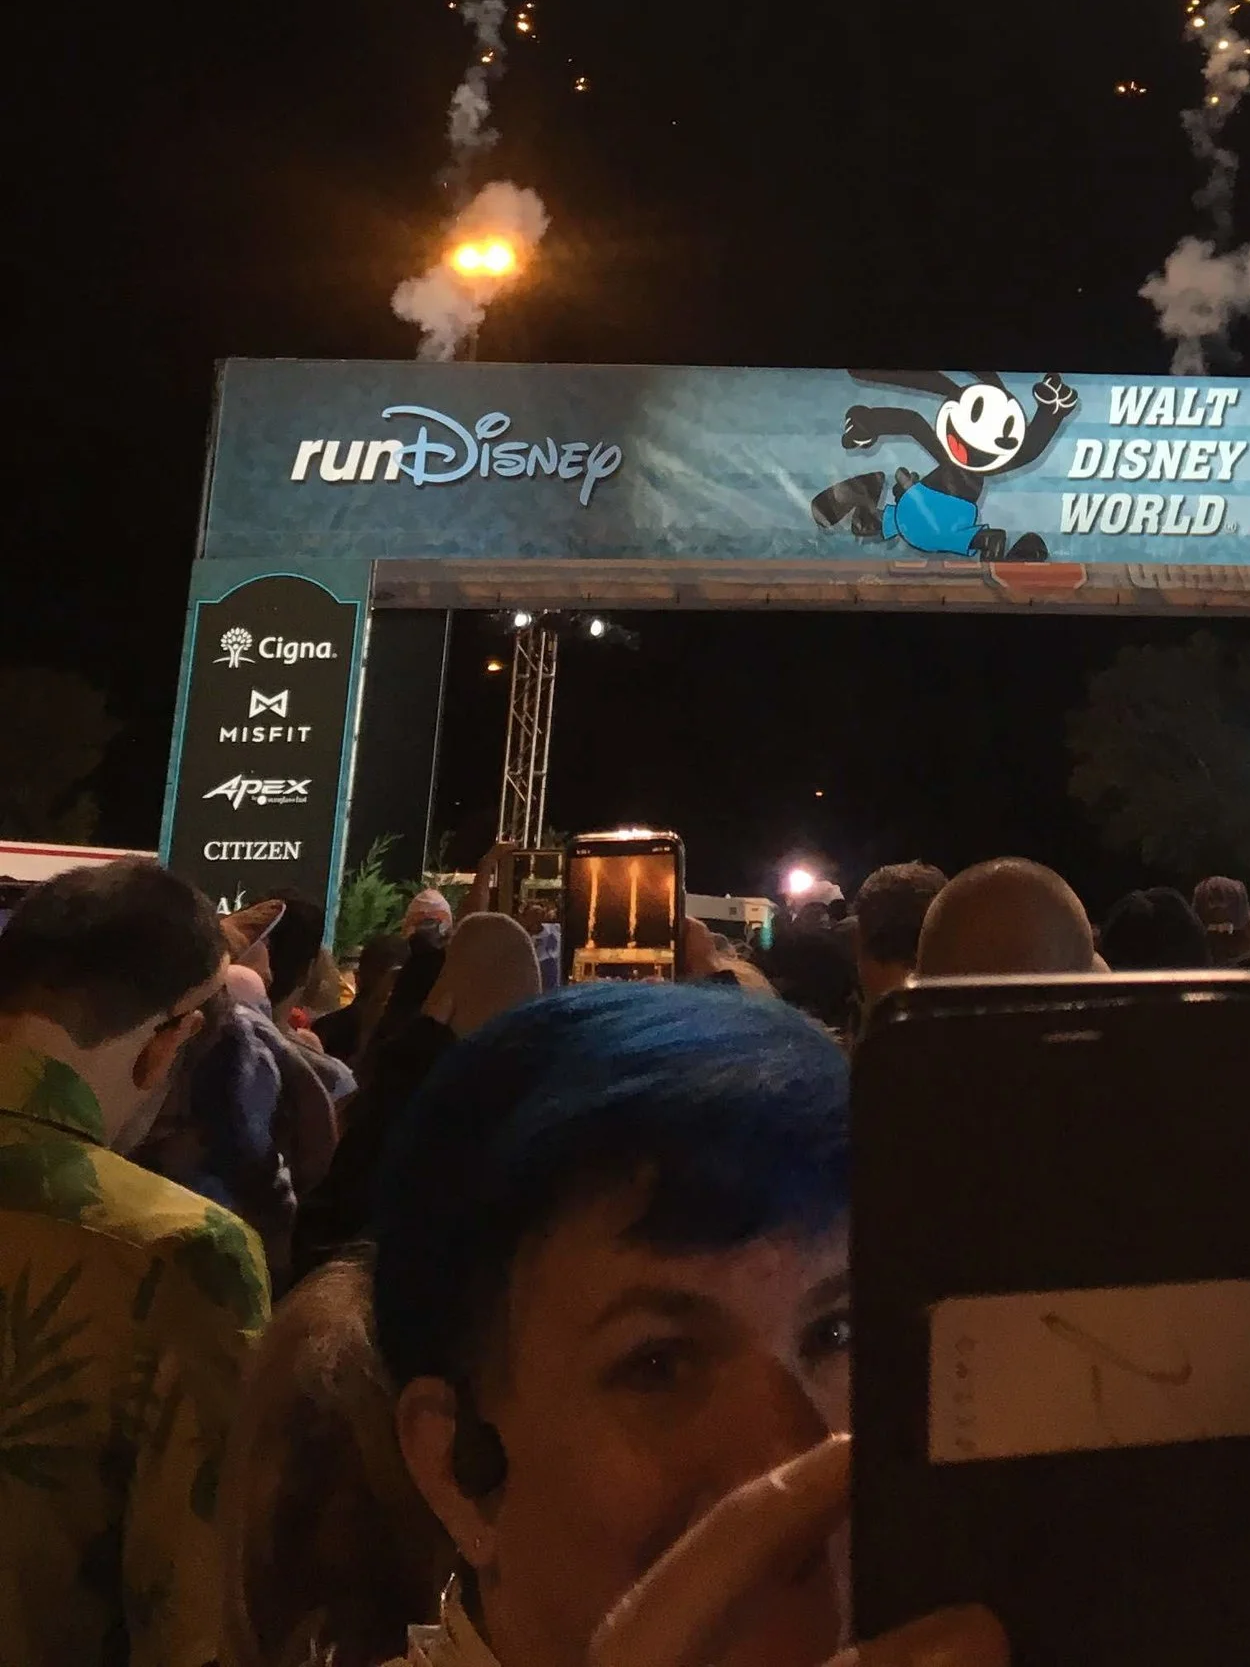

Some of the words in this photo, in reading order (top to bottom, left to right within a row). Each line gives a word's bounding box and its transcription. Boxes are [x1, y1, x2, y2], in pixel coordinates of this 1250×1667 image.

[1109, 386, 1239, 427] WALT
[1067, 439, 1248, 481] DISNEY
[1060, 493, 1227, 536] WORLD
[258, 636, 332, 664] Cigna
[218, 726, 312, 743] MISFIT
[202, 774, 312, 811] APEX
[203, 841, 302, 861] CITIZEN
